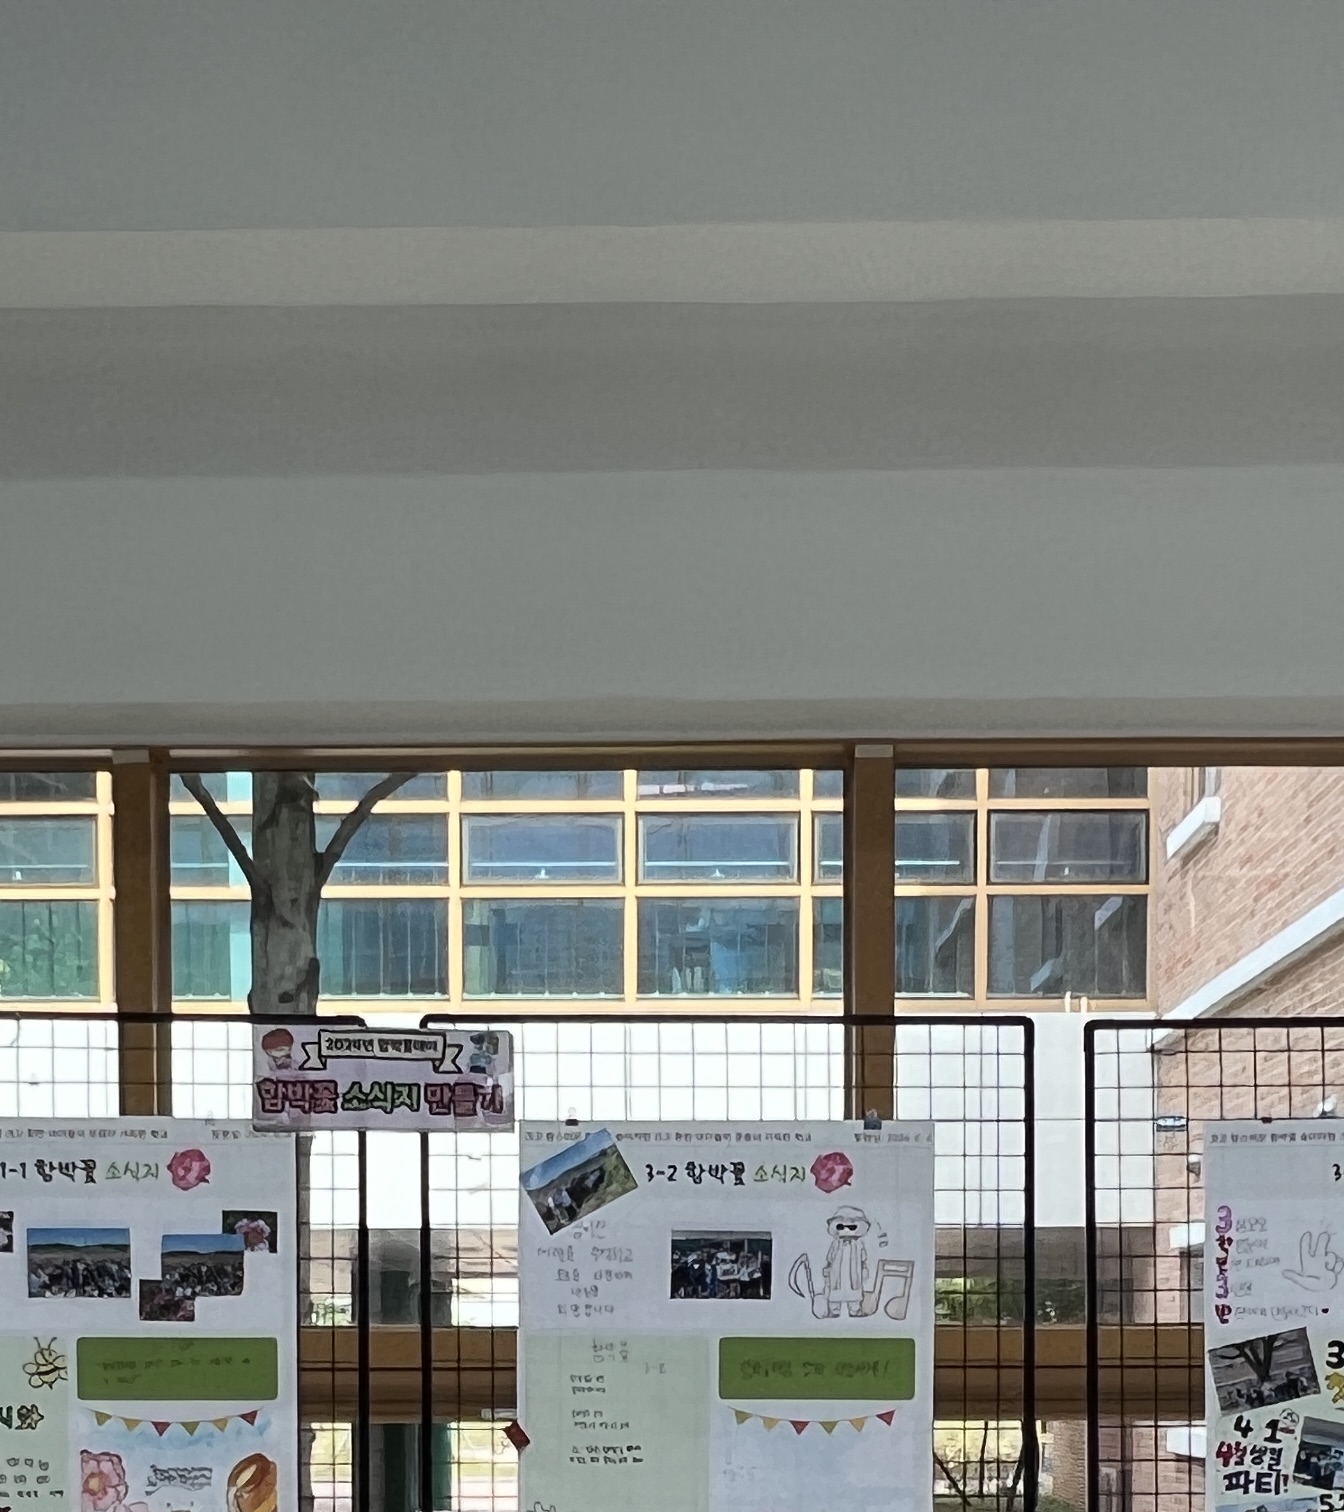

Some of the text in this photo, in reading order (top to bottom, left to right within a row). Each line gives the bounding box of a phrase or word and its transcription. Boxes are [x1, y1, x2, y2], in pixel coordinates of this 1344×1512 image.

[341, 1081, 420, 1113] 소식지
[0, 1158, 160, 1184] 1-1 함박꽃 소식지
[645, 1160, 807, 1186] 3-2 함박꽃 소식지
[1222, 1470, 1290, 1496] 파티!
